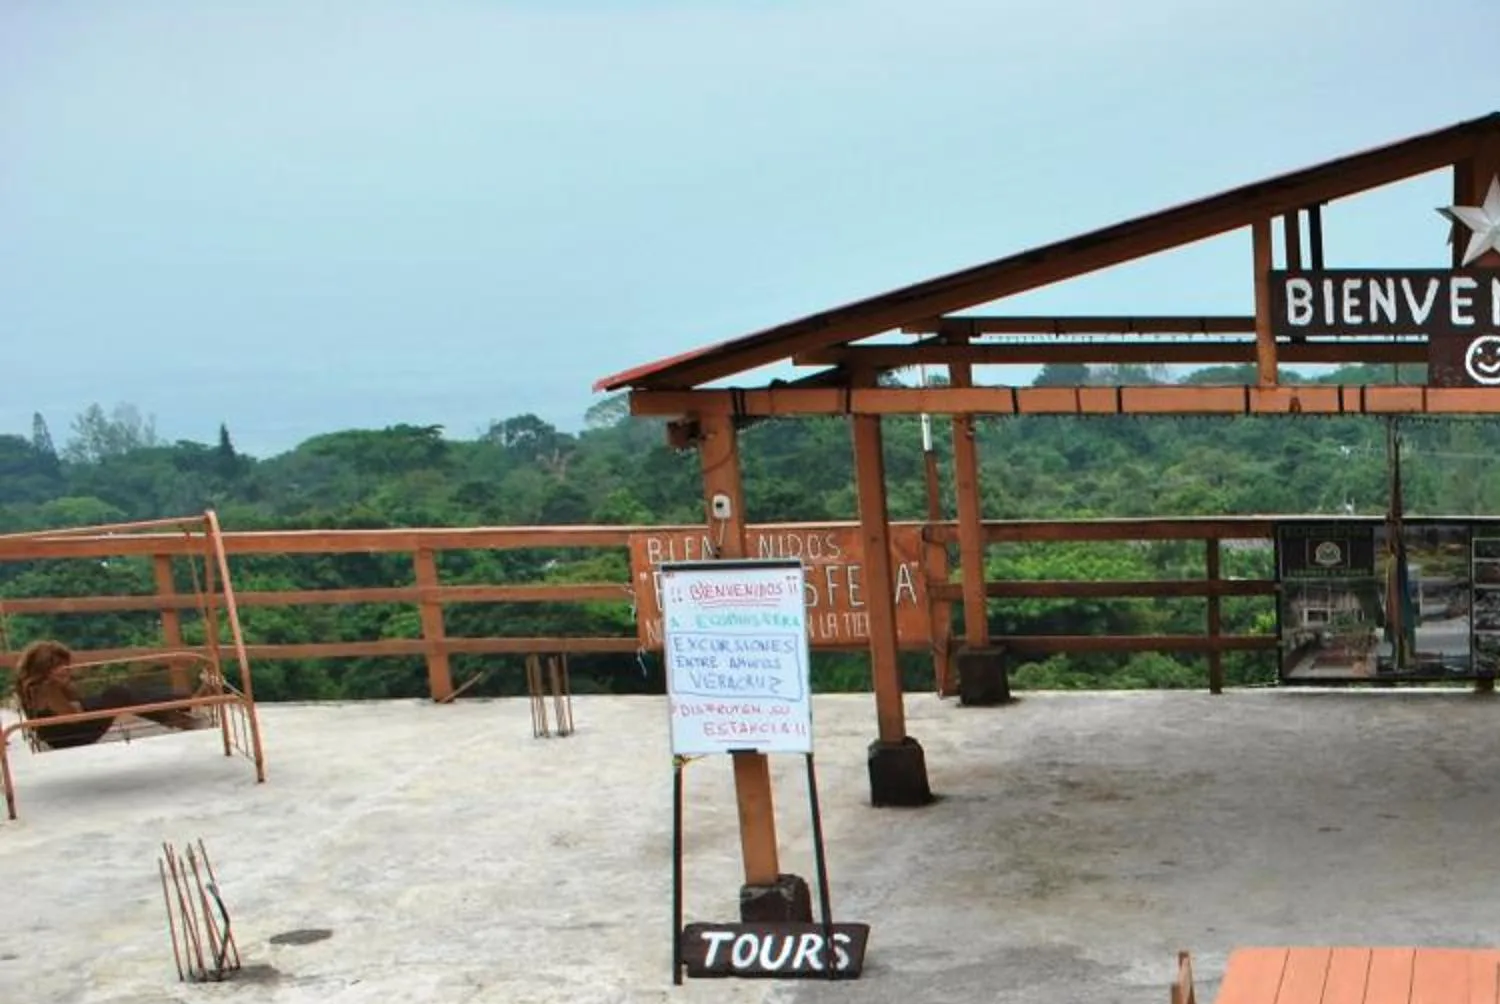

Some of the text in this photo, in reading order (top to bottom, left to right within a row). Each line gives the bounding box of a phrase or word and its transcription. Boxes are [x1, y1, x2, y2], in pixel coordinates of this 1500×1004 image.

[647, 532, 841, 564] BIENNIDOS
[673, 636, 796, 653] EXCURSIONES
[676, 655, 719, 669] ENTRE
[688, 671, 783, 694] VERACRUZ
[701, 931, 851, 970] TOURS
